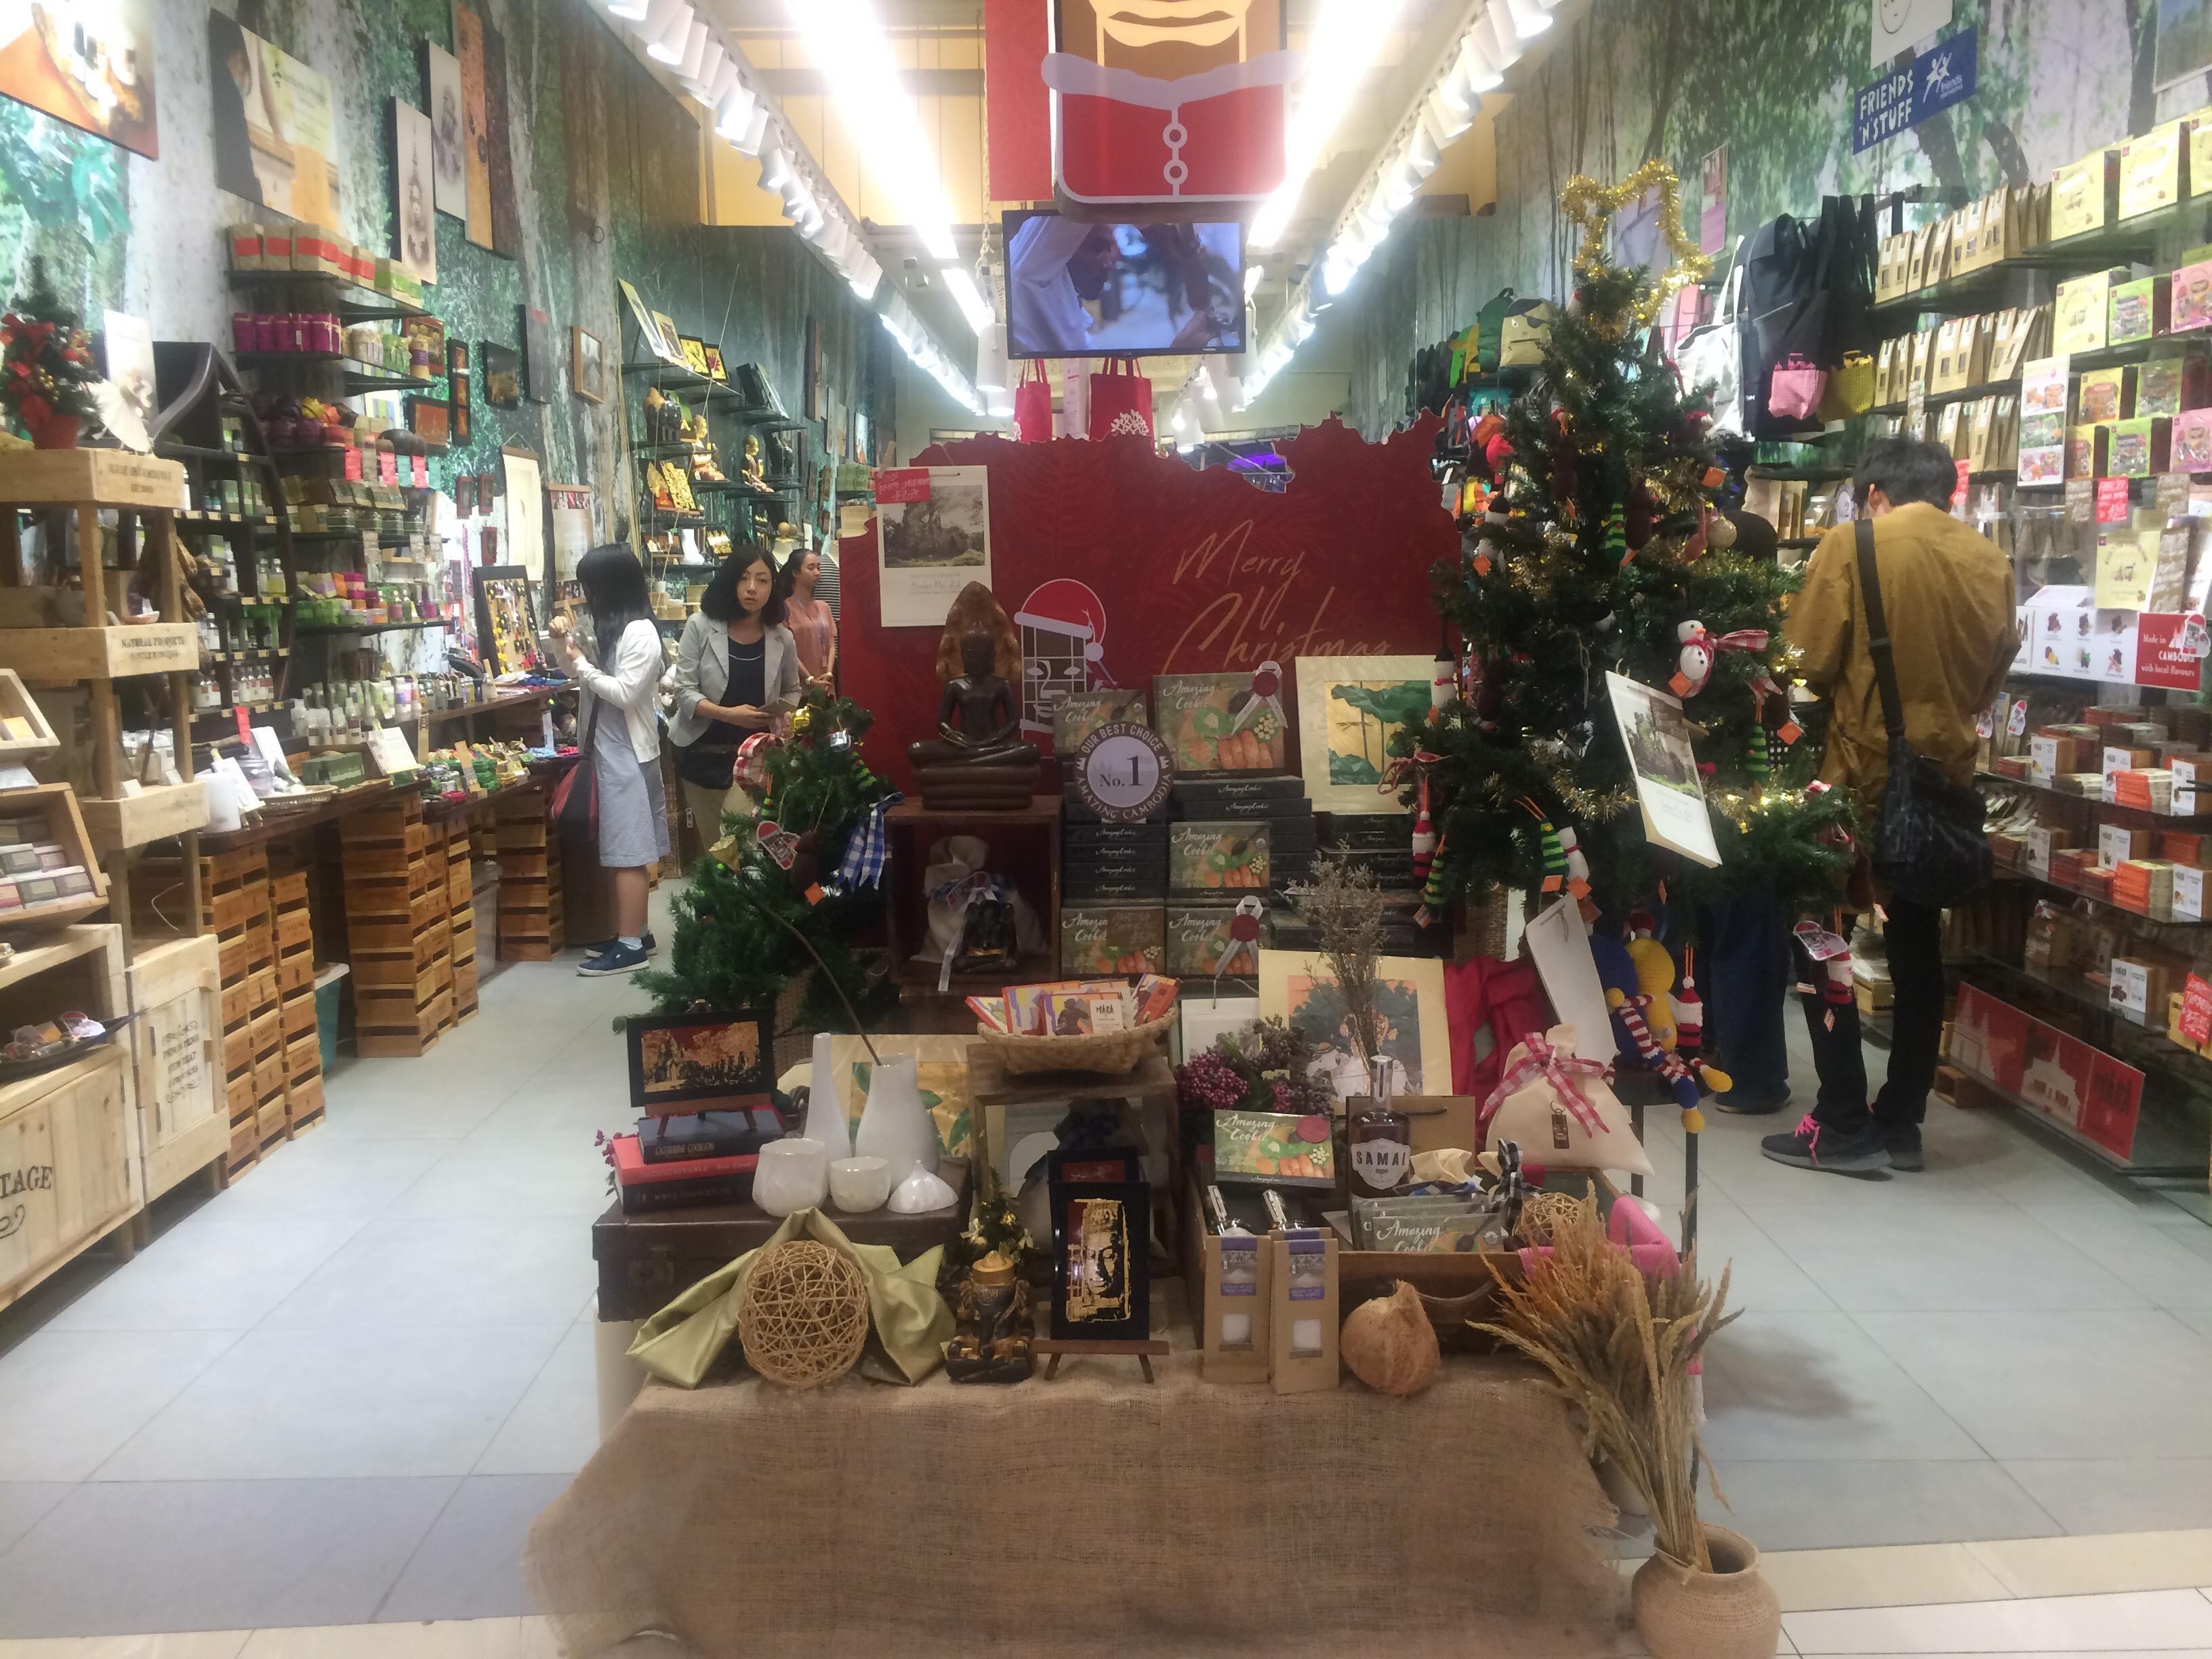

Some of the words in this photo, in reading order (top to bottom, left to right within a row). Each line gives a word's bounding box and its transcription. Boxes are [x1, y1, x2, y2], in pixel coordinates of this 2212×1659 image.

[1860, 68, 1914, 121] FRIENDS
[1172, 519, 1305, 632] Merry
[1160, 586, 1392, 676] Christmas
[2143, 634, 2158, 644] Made
[2159, 635, 2167, 644] in
[121, 638, 152, 648] NATURAL
[2142, 663, 2154, 672] with
[2155, 664, 2169, 674] local
[1163, 680, 1215, 698] Amazing
[1054, 696, 1102, 713] Amazing
[1175, 696, 1210, 710] Cookie
[1081, 733, 1101, 754] OUR
[1099, 723, 1126, 739] BEST
[1130, 724, 1164, 752] CHOICE
[1099, 773, 1126, 787] No.
[1126, 755, 1144, 787] 1
[1076, 776, 1118, 819] AMAZING
[1122, 773, 1171, 820] CAMBODIA
[1171, 827, 1223, 847] Amazing
[1183, 843, 1216, 857] Cookie
[1062, 913, 1108, 934] Amazin
[1168, 913, 1223, 934] Amazing
[1216, 1113, 1275, 1134] Amazing
[1229, 1128, 1266, 1143] Cookie
[1356, 1151, 1406, 1166] SAMAI
[1376, 1219, 1441, 1244] Amazing
